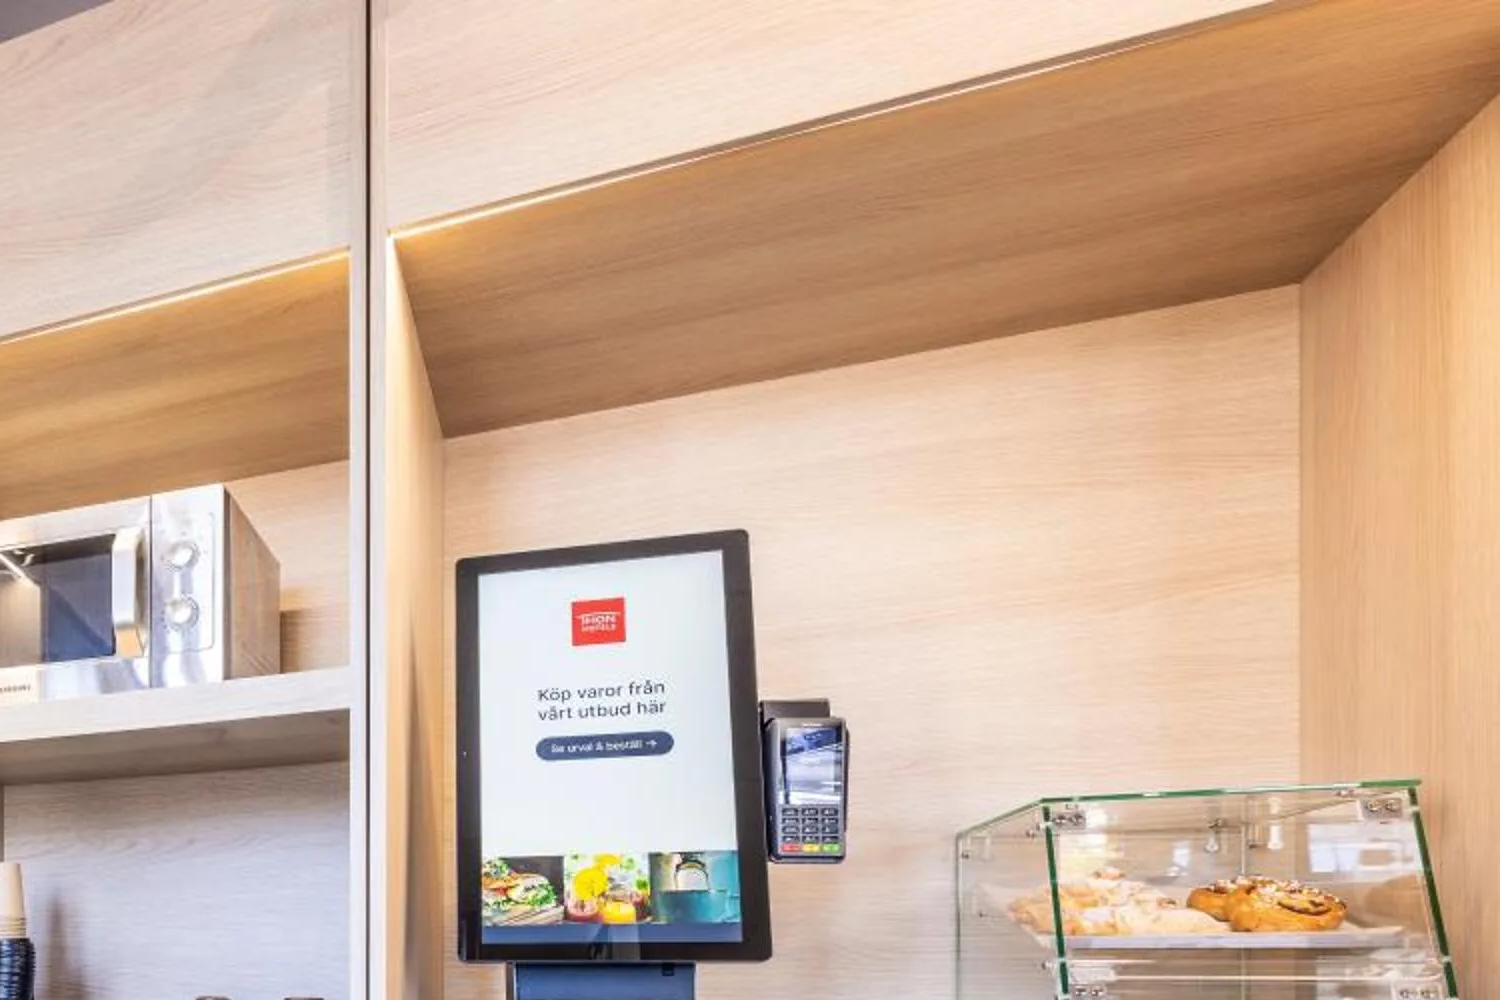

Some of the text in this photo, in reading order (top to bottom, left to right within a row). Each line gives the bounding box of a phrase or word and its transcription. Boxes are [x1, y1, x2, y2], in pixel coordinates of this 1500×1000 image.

[538, 679, 666, 703] Köp varor från
[538, 699, 666, 721] vårt utbud här
